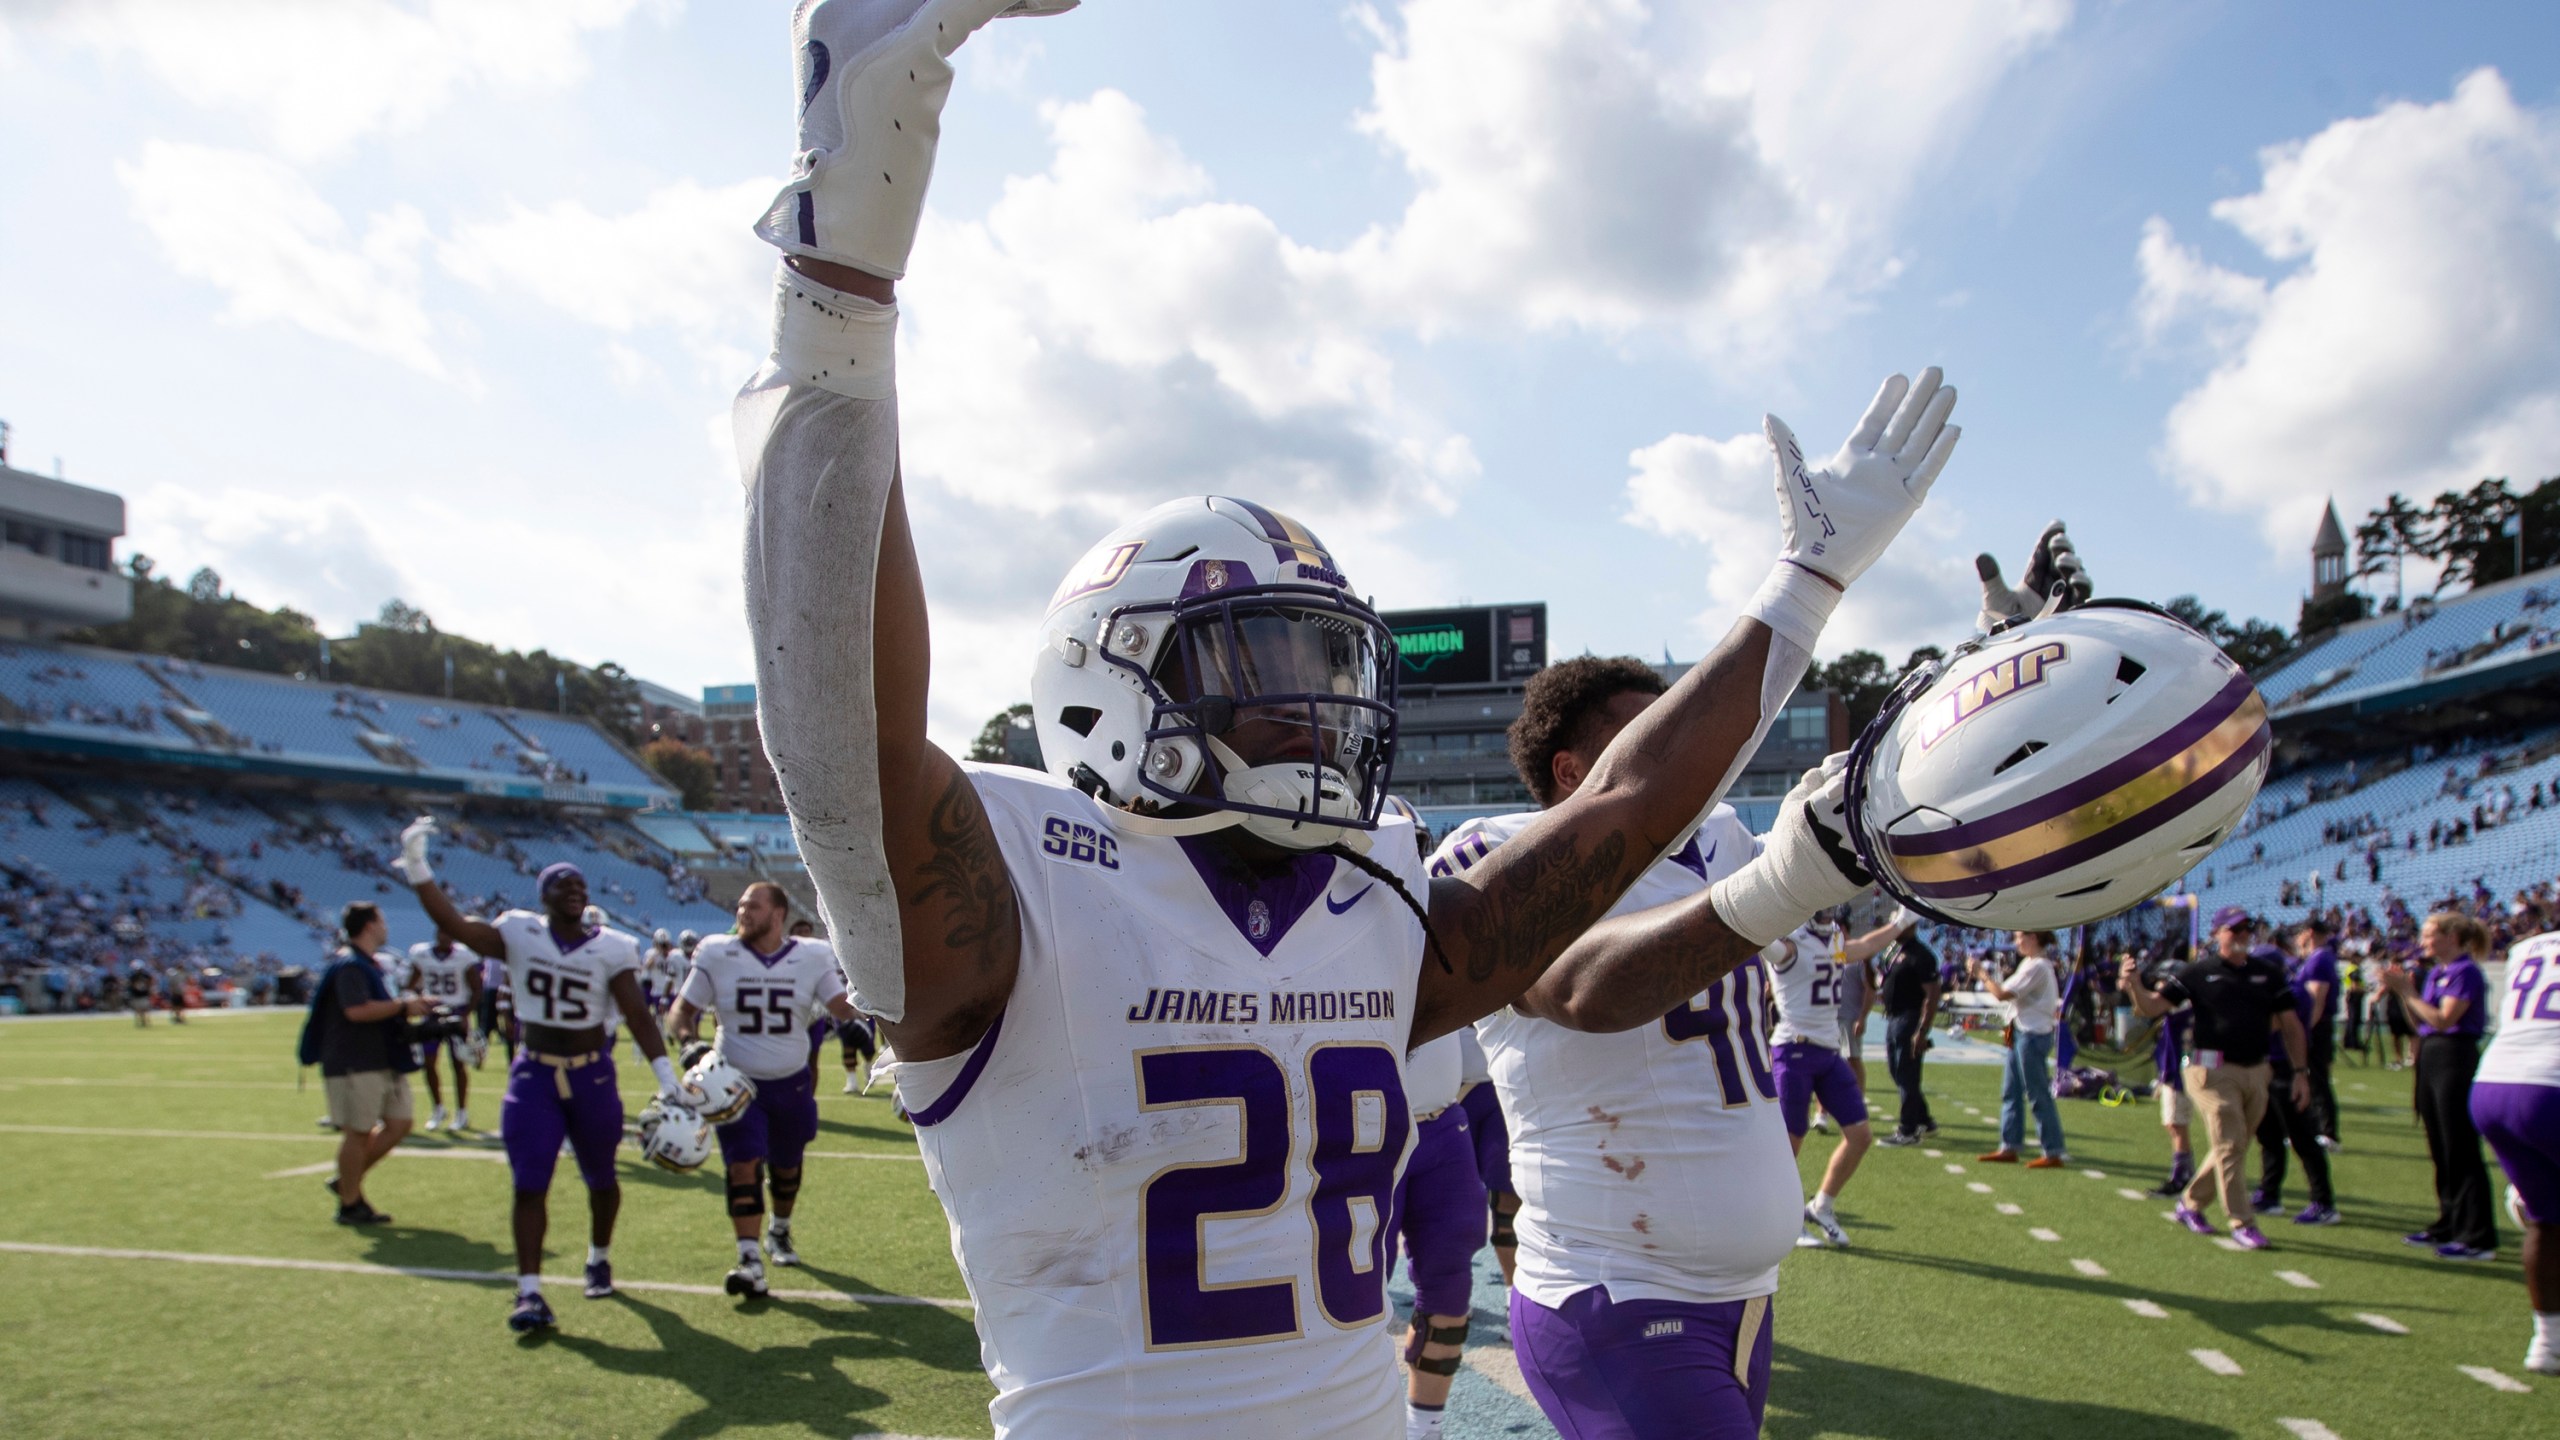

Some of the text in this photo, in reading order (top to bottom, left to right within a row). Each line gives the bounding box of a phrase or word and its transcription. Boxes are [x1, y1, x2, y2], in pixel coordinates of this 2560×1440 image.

[1296, 563, 1348, 589] DUKES
[1044, 817, 1119, 870] SBC
[427, 972, 459, 995] 26
[526, 969, 590, 1021] 95
[736, 987, 794, 1035] 55
[1127, 987, 1395, 1024] JAMES MADISON
[1133, 1040, 1412, 1352] 28
[1644, 1320, 1683, 1337] JMU
